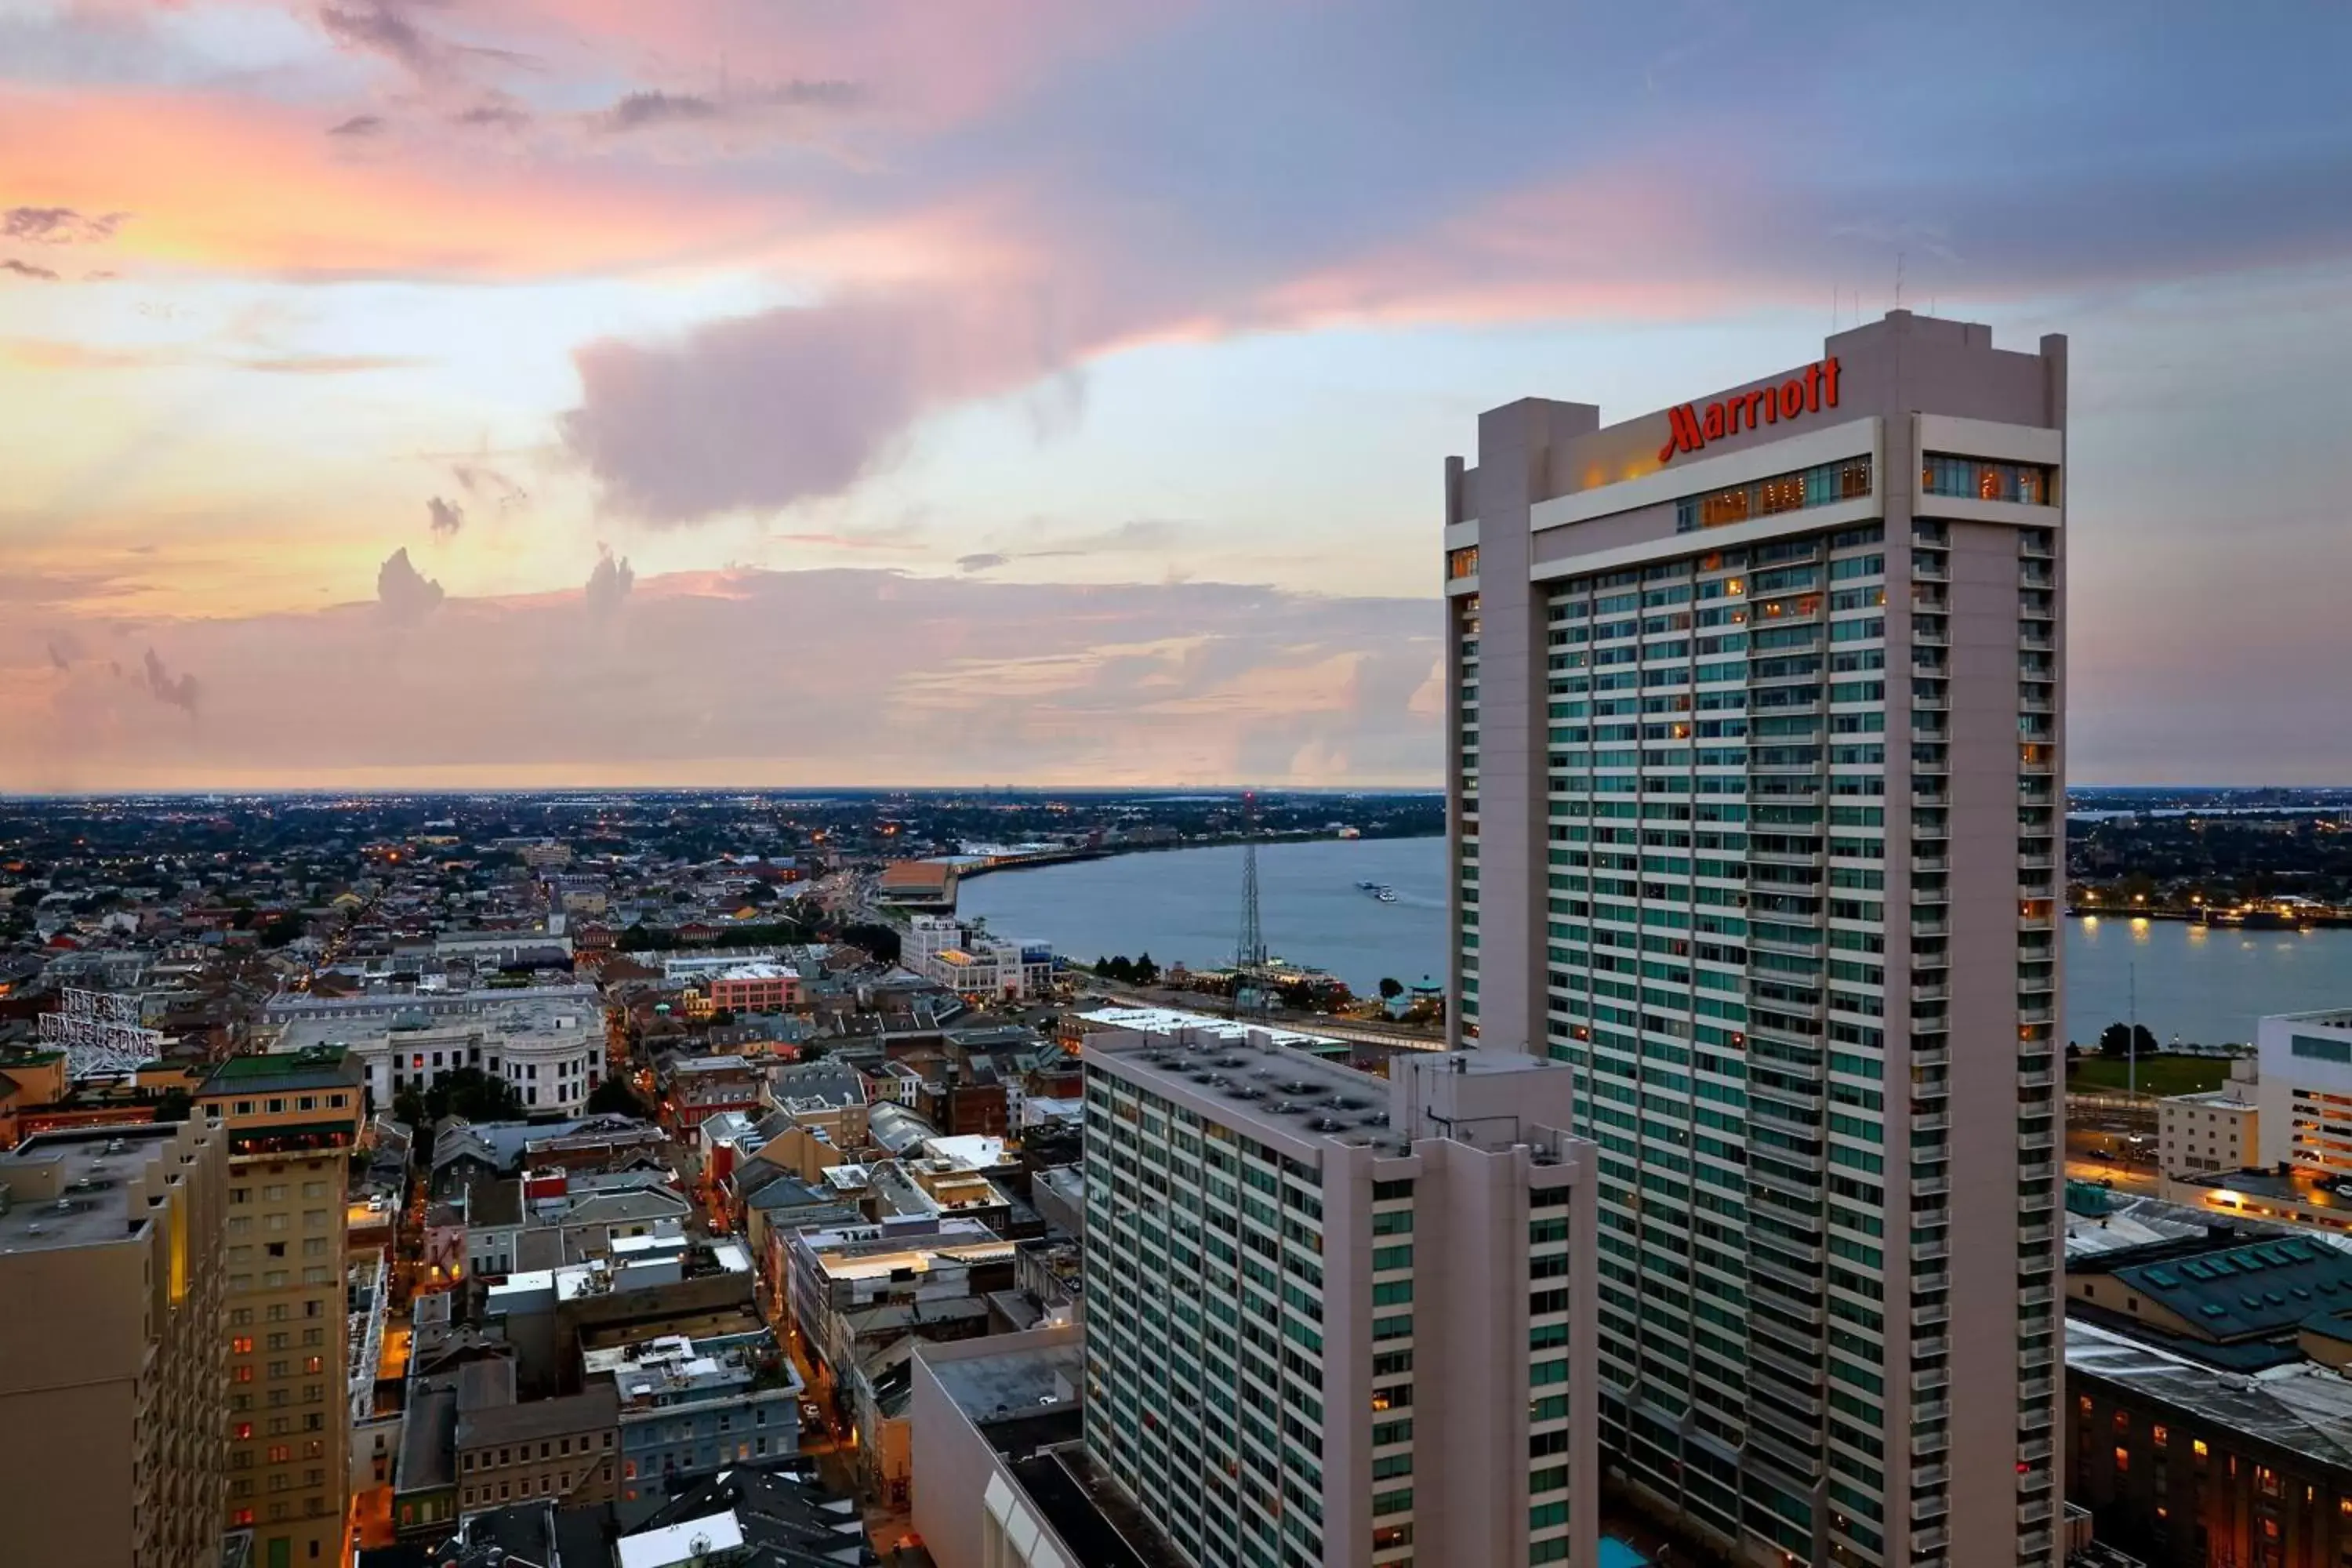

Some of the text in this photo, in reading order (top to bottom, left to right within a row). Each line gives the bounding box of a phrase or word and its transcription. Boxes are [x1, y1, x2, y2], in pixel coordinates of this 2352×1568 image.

[1658, 357, 1841, 463] Marriott
[63, 989, 125, 1021] HOTEL
[39, 1014, 155, 1057] MONTELEONE
